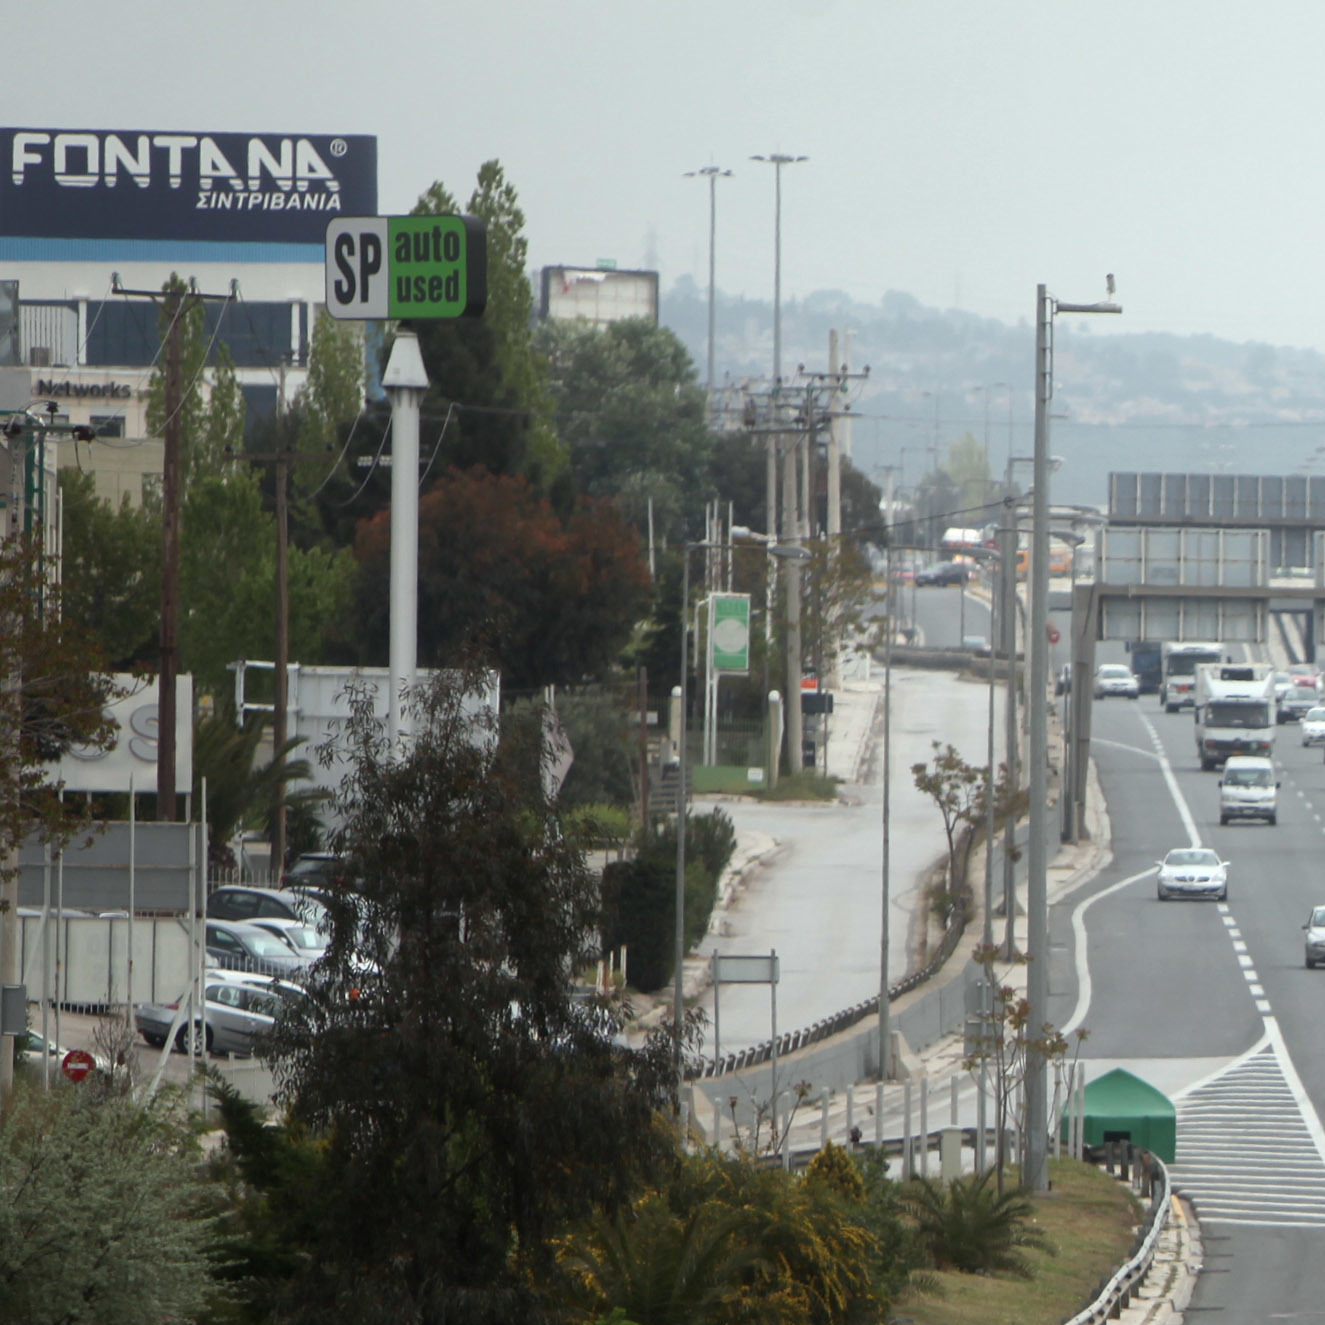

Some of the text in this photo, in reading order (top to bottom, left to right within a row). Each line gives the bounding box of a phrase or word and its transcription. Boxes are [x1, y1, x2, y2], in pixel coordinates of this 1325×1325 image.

[12, 133, 341, 191] FONTANA
[196, 191, 341, 211] ΣΙΝΤΡΙΒΑΝΙΑ
[395, 226, 460, 262] auto
[334, 232, 382, 305] SP
[396, 269, 459, 302] used
